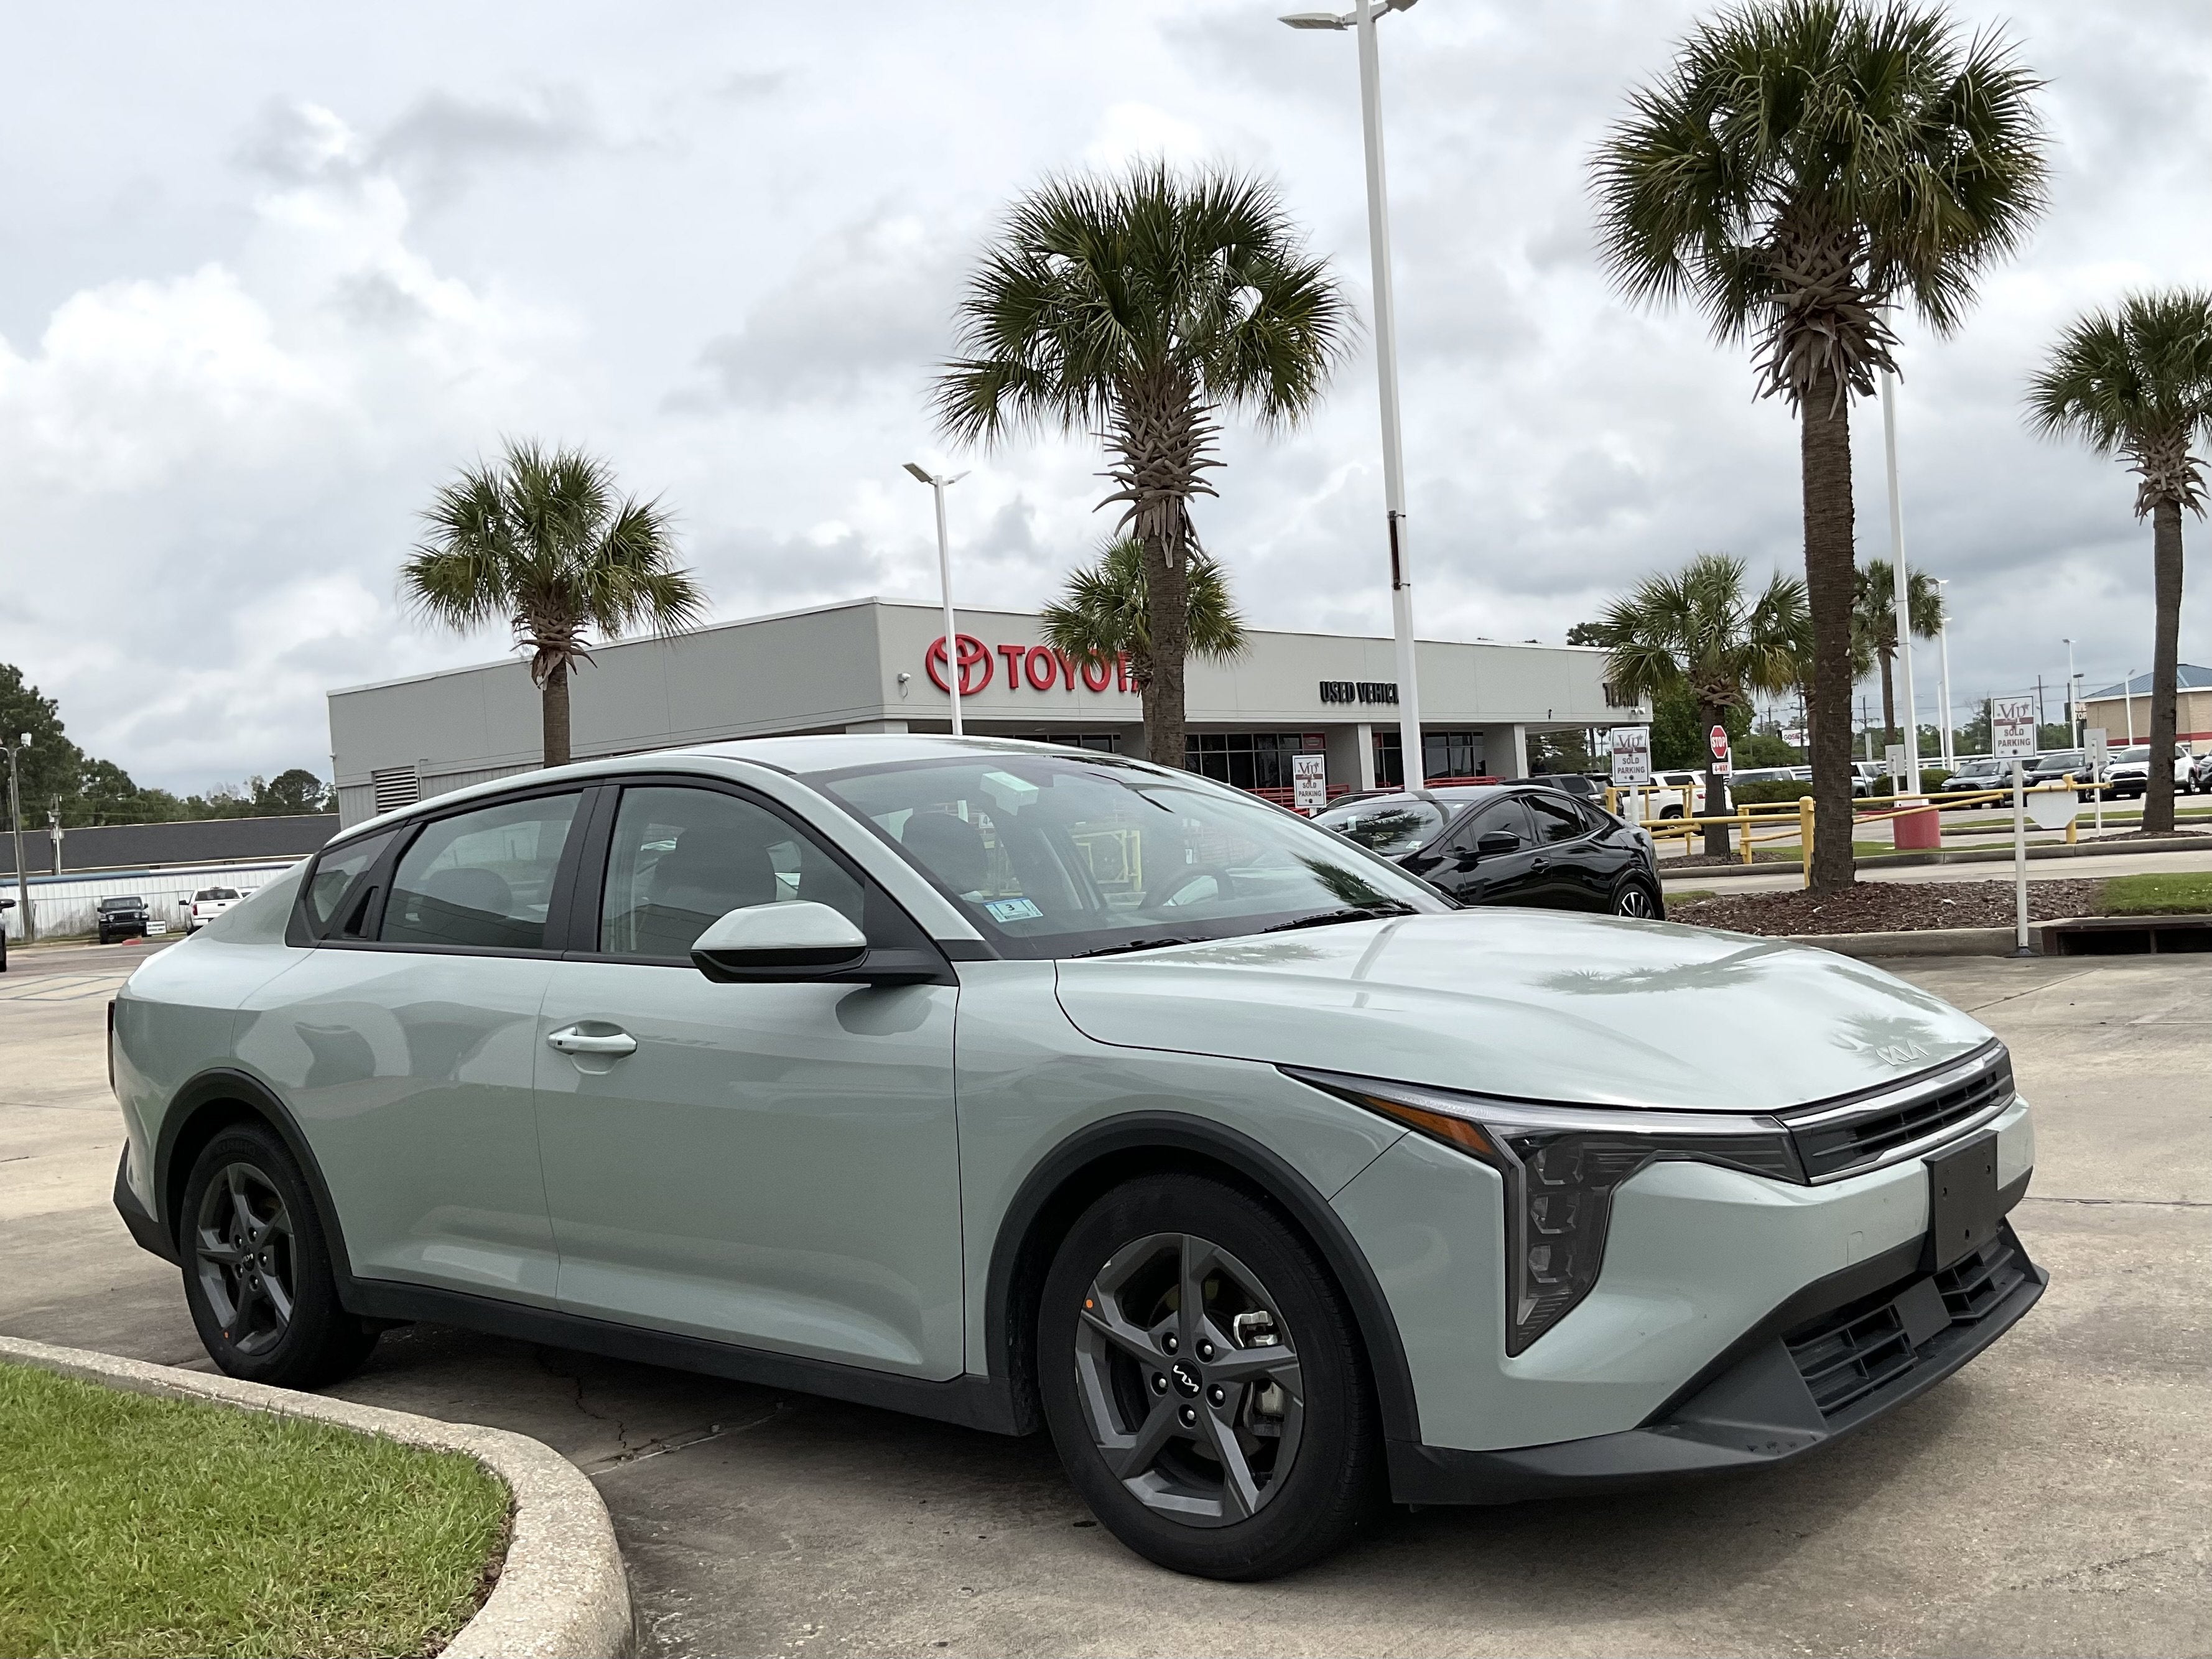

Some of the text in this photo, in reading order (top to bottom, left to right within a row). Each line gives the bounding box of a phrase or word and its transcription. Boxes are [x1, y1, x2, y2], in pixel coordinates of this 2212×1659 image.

[998, 644, 1138, 692] TOYOT
[1319, 681, 1356, 703] USED
[2003, 728, 2025, 737] SOLD
[1711, 736, 1726, 748] STOP
[1997, 738, 2031, 748] PARKING
[1617, 766, 1645, 774] PARKING
[1714, 764, 1728, 772] 4-WAY
